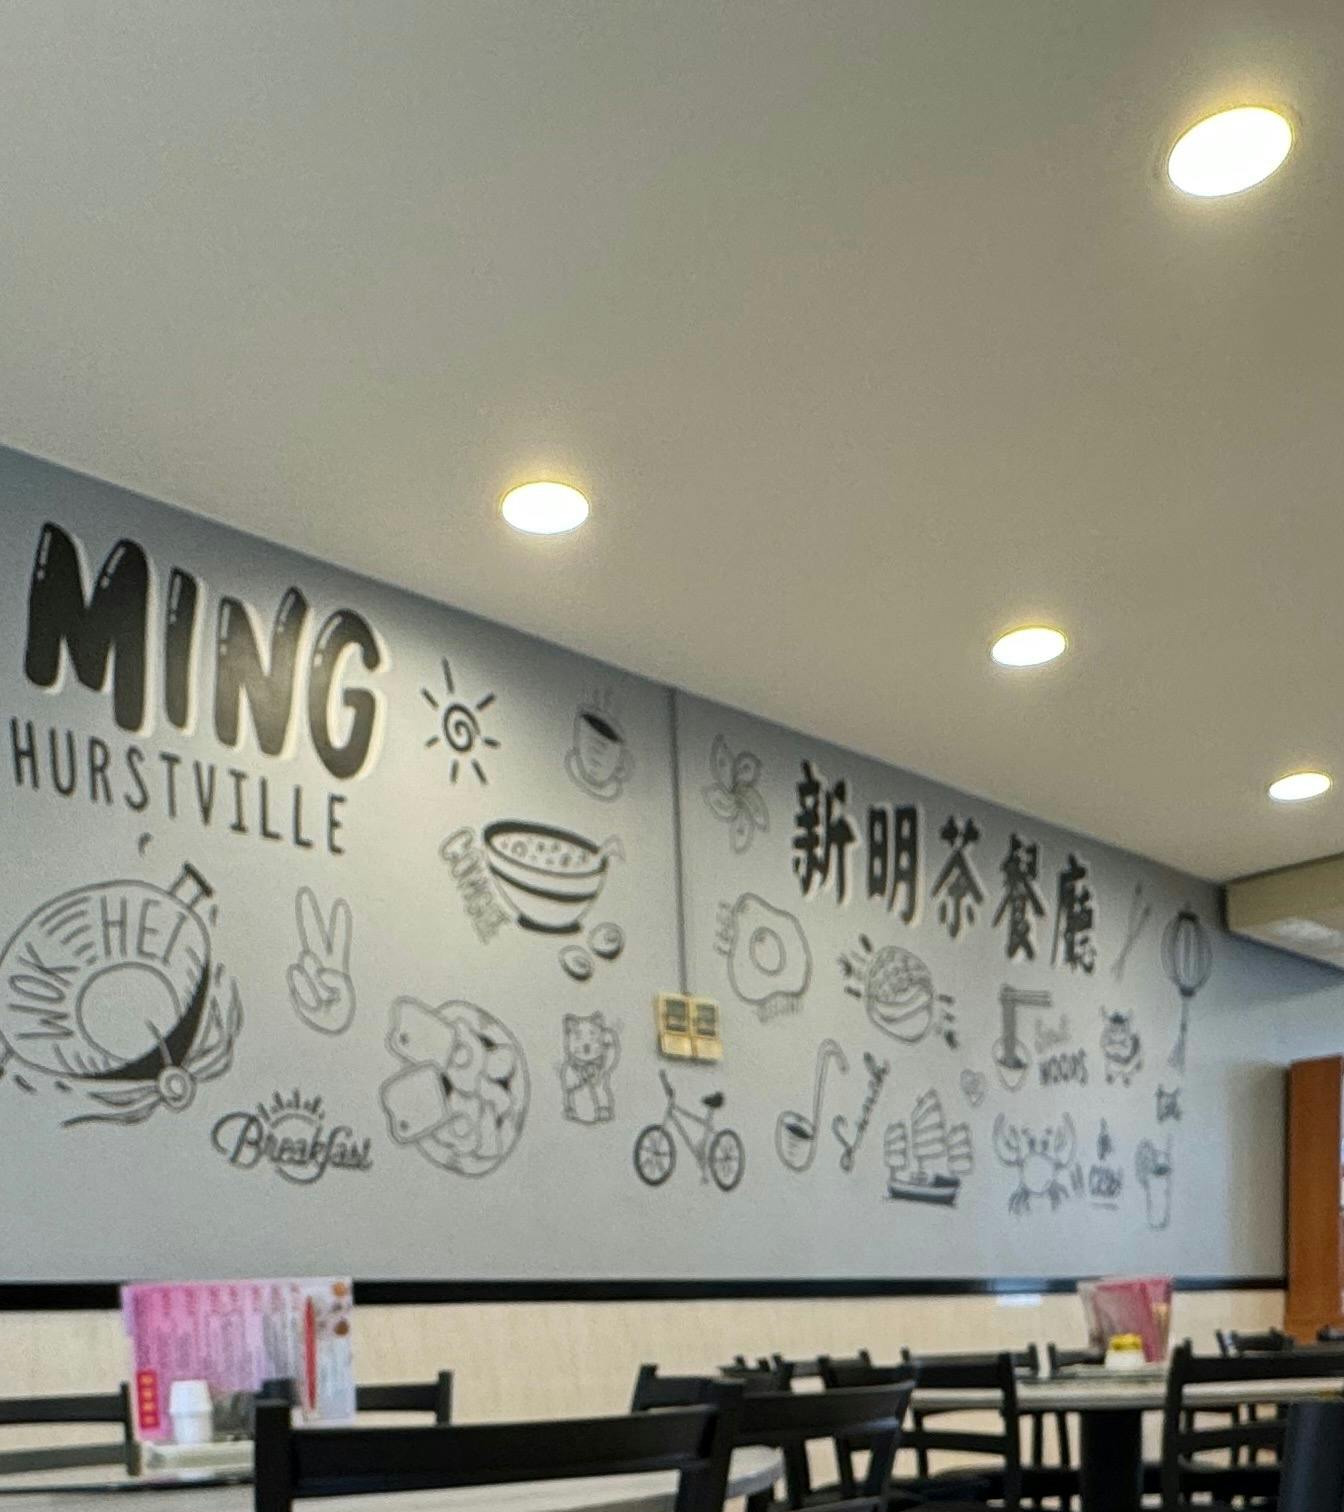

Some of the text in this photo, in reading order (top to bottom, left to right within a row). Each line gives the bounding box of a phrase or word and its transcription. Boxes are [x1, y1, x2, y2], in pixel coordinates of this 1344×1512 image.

[23, 521, 393, 781] MING
[8, 716, 350, 856] HURSTVILLE
[791, 758, 1097, 977] 新明茶餐廳
[210, 1110, 374, 1185] Breakfast
